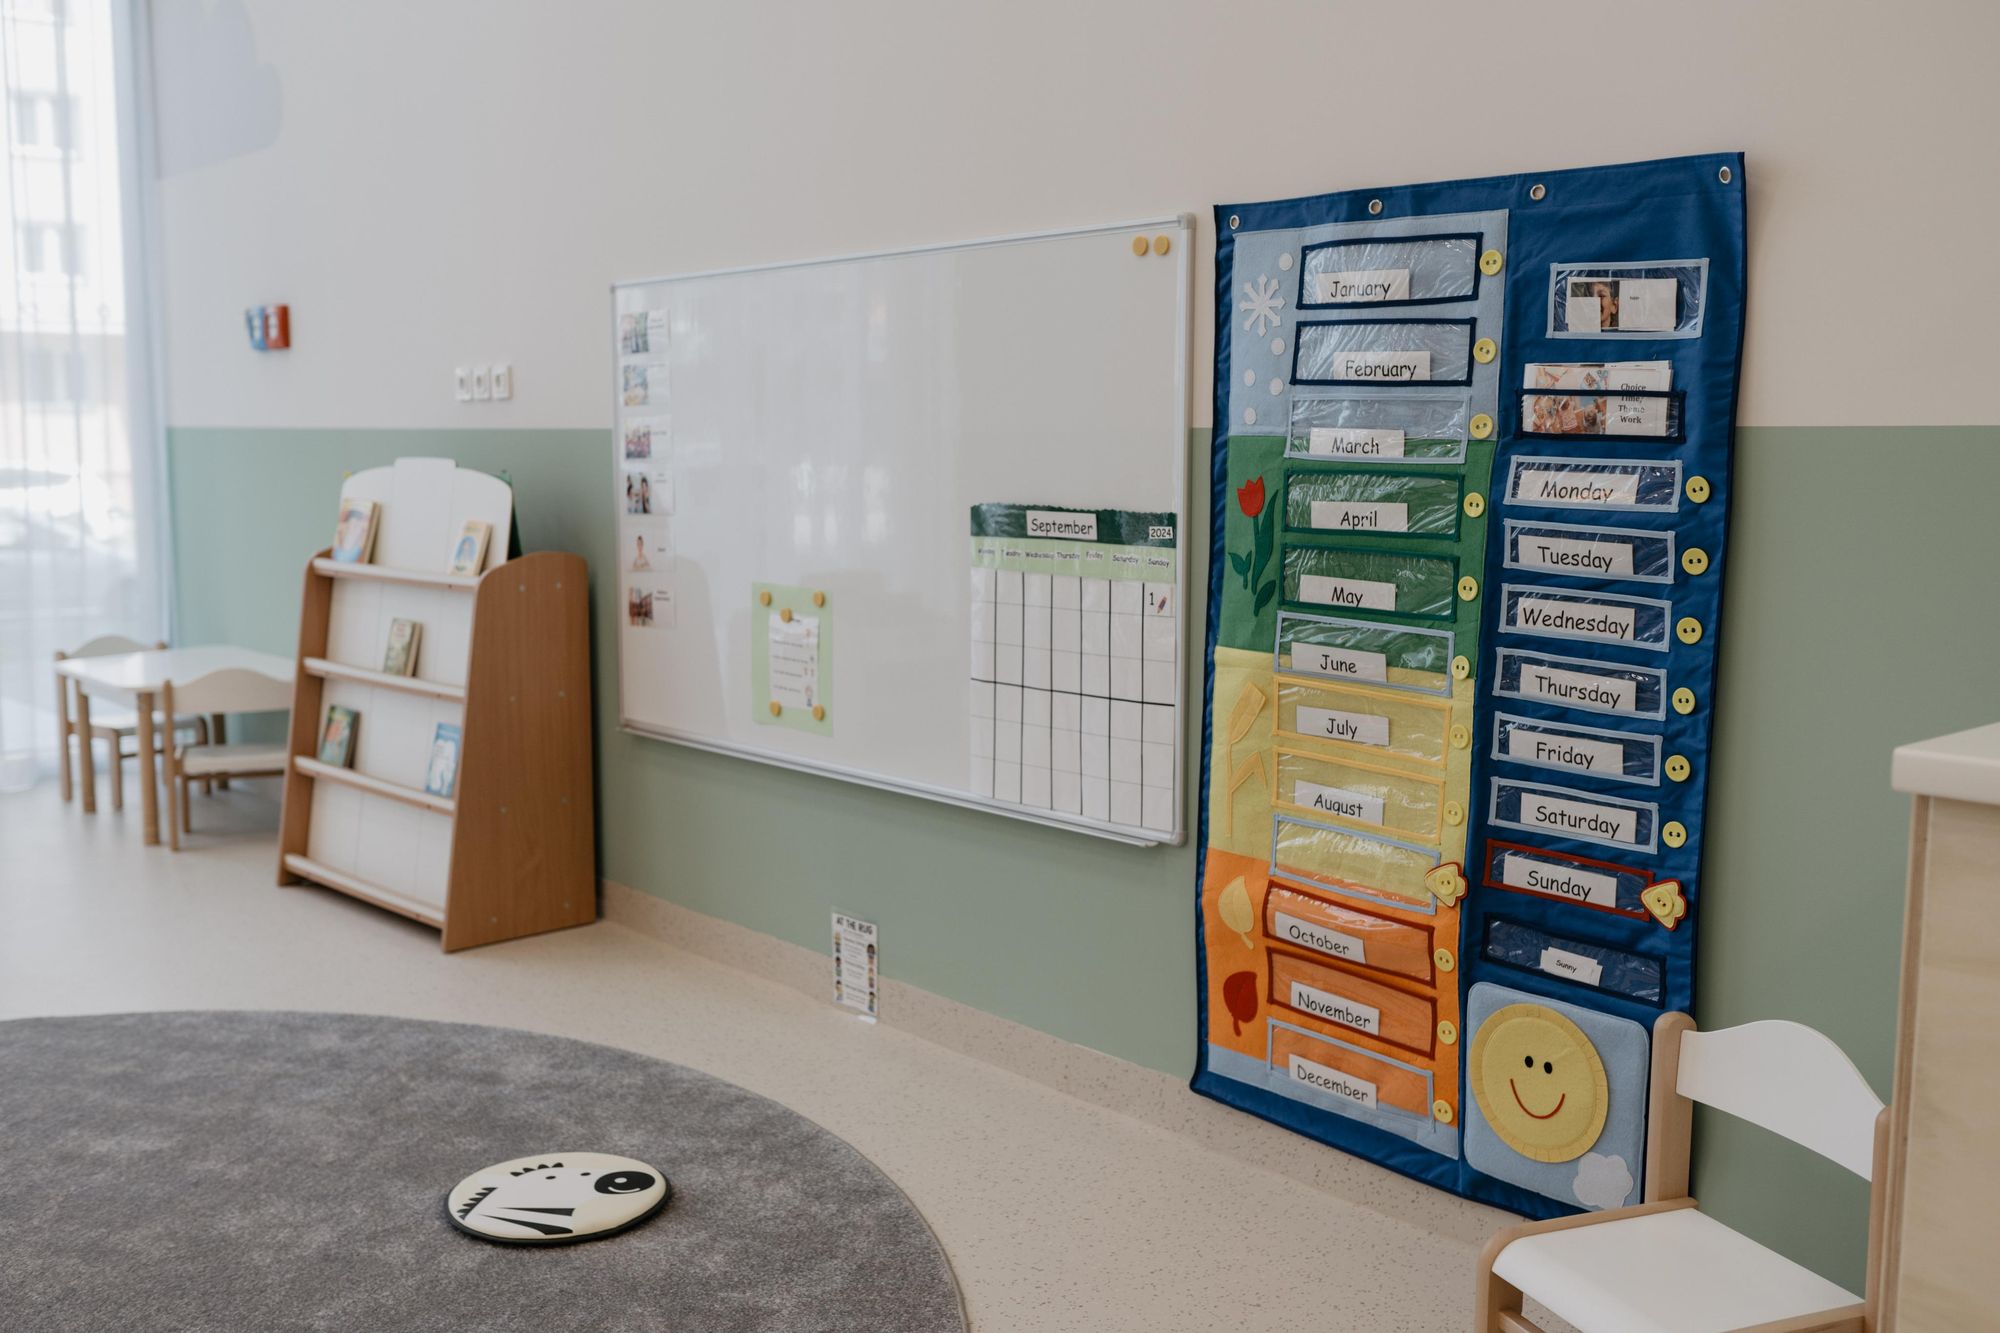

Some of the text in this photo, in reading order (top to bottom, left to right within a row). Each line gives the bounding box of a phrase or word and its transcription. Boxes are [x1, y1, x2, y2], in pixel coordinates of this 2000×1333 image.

[1330, 281, 1391, 299] January
[1345, 360, 1417, 380] February
[1620, 383, 1647, 391] Choice
[1331, 439, 1379, 454] March
[1540, 480, 1613, 503] Monday
[1031, 518, 1172, 538] September 2024
[1340, 511, 1377, 529] April
[1148, 558, 1169, 568] Sunday
[1537, 546, 1613, 573] Tuesday
[1149, 592, 1154, 606] 1
[1331, 586, 1363, 608] May
[1523, 607, 1629, 640] Wednesday
[1320, 654, 1357, 674] June
[1535, 675, 1621, 709] Thursday
[1326, 718, 1358, 740] July
[1536, 742, 1594, 770] Friday
[1314, 794, 1363, 818] August
[1535, 806, 1620, 839] Saturday
[1527, 870, 1592, 902] Sunday
[1289, 925, 1349, 955] October
[1556, 959, 1577, 973] Sunny
[1298, 992, 1370, 1028] November
[1297, 1064, 1368, 1102] December
